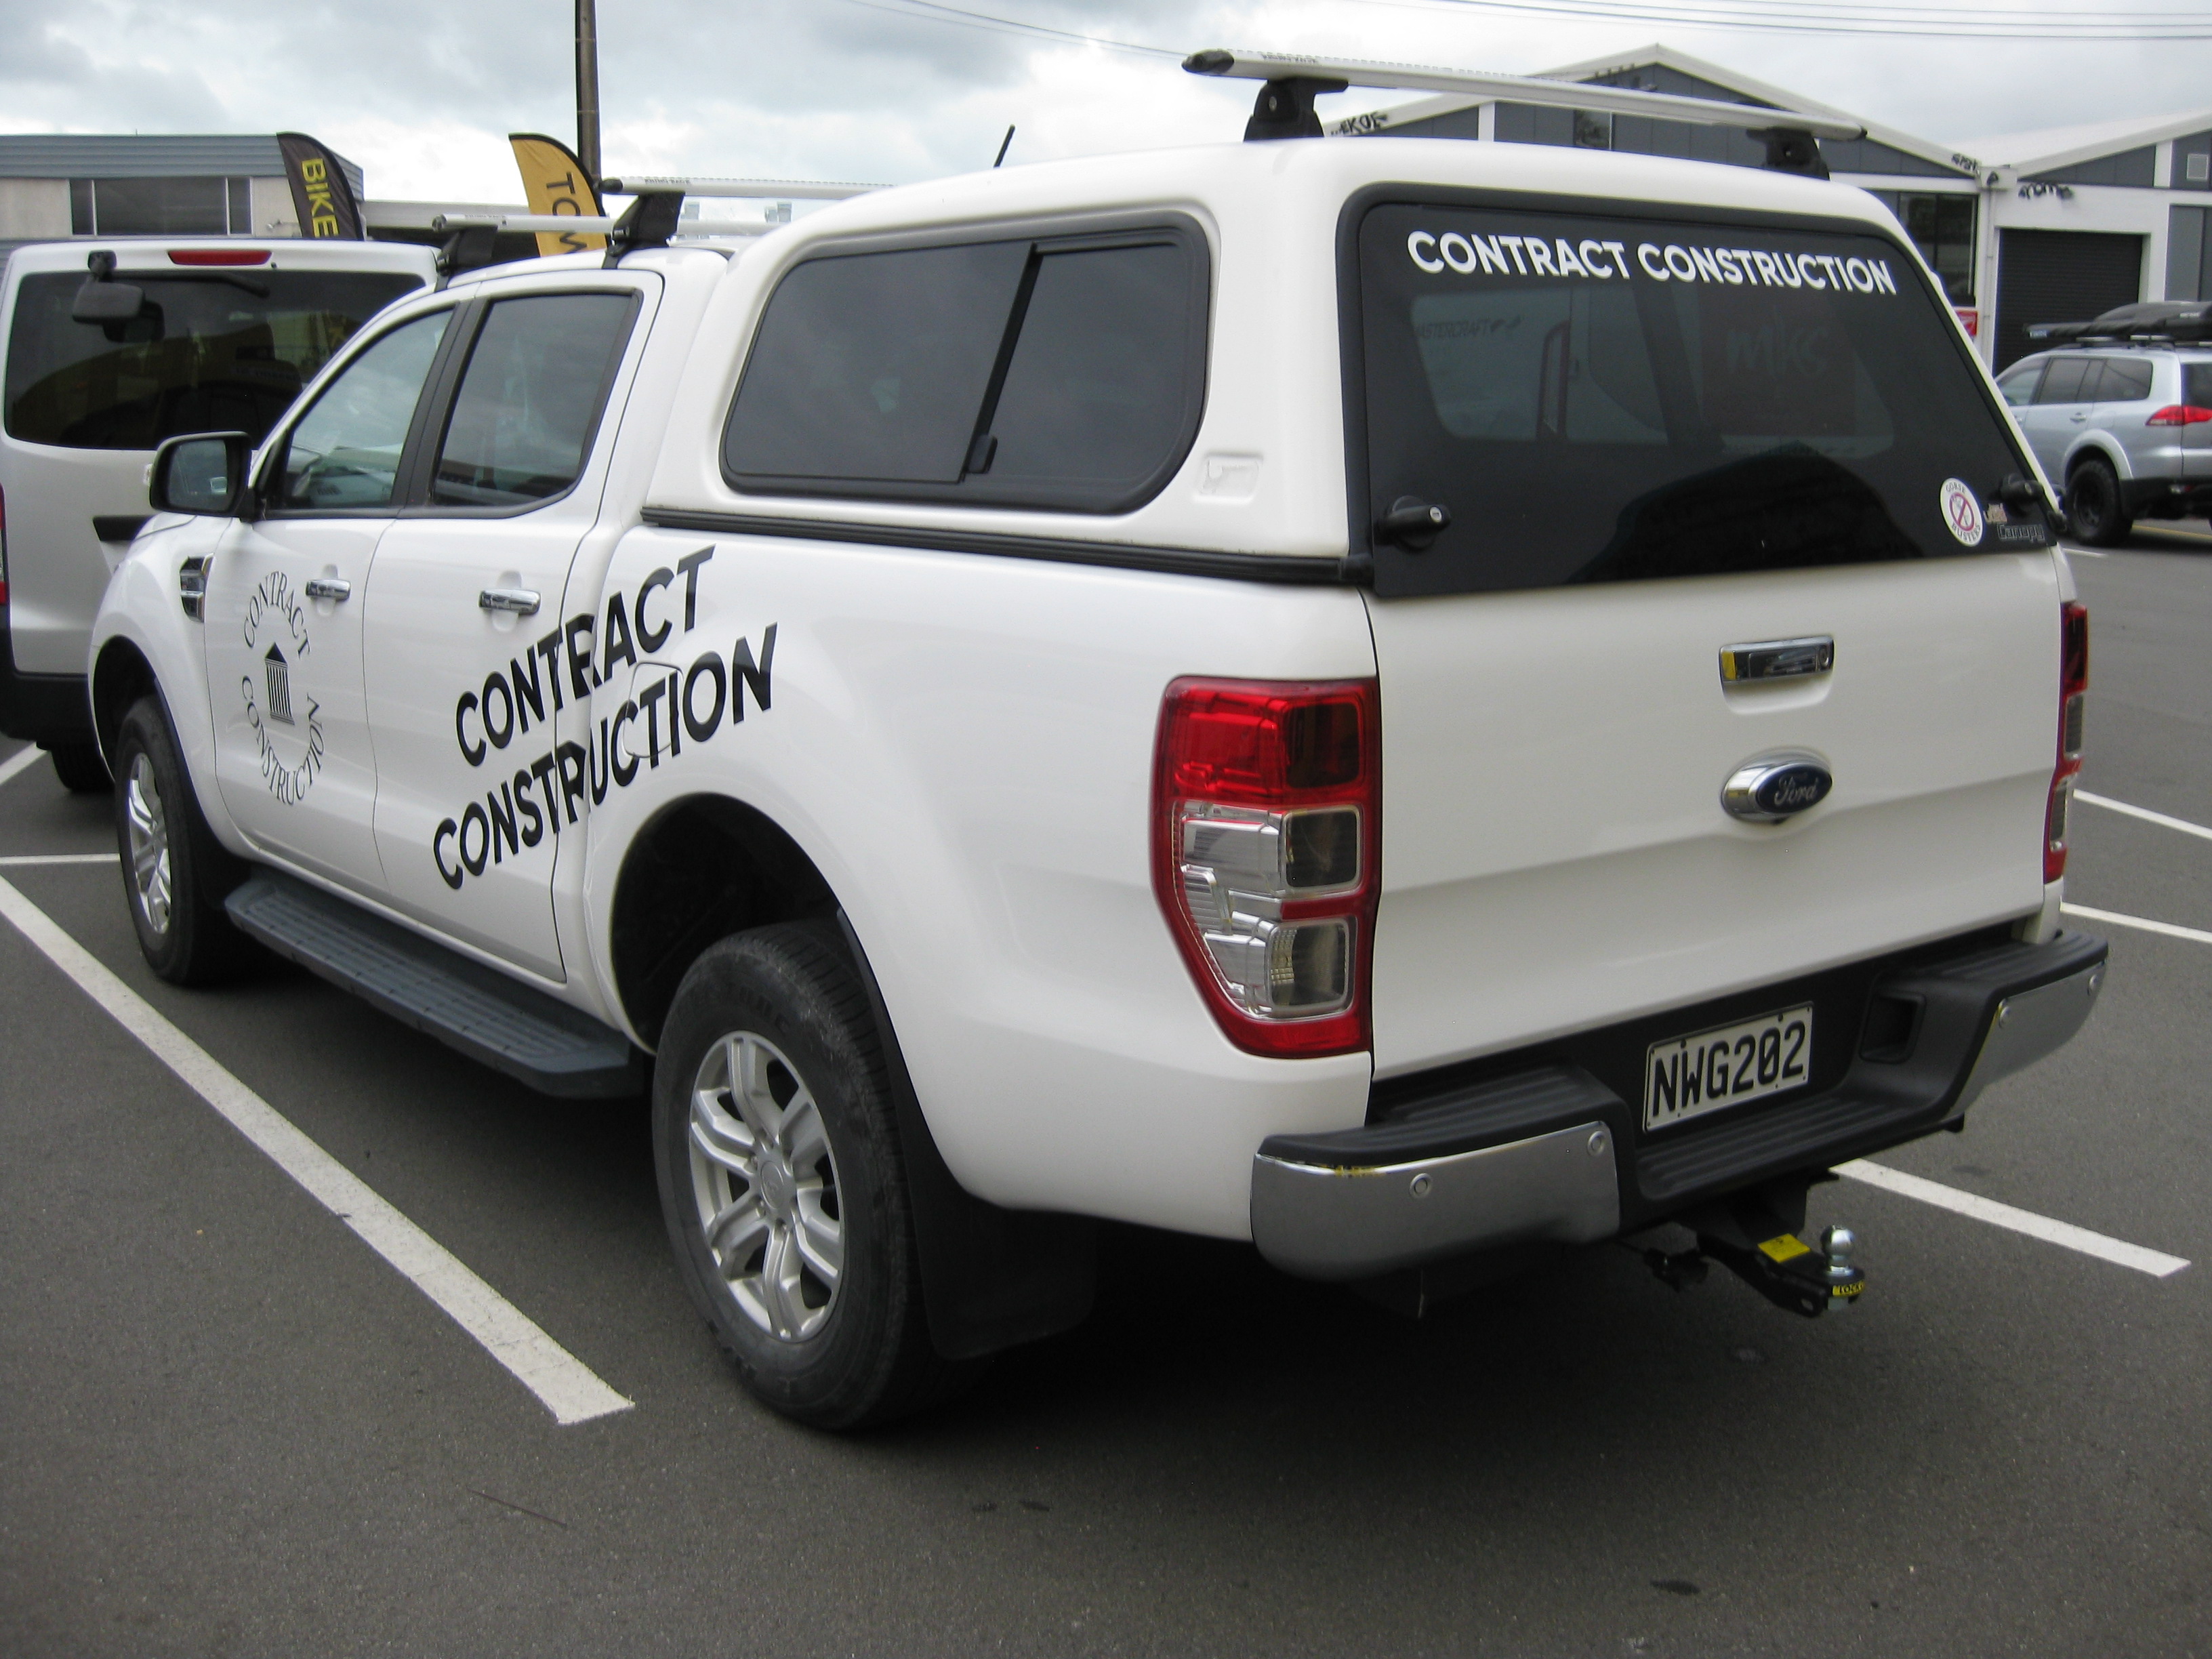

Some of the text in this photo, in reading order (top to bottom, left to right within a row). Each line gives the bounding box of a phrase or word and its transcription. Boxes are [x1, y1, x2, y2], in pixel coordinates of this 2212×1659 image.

[302, 158, 339, 238] BIKE
[1407, 231, 1897, 295] CONTRACT CONSTRUCTION
[1951, 523, 1981, 542] BUSTERS
[1998, 525, 2045, 541] Canopy
[244, 571, 310, 660] CONTRACT
[456, 544, 716, 766] CONTRACT
[242, 676, 325, 806] CONSTRUCTION
[434, 622, 777, 889] CONSTRUCTION
[1774, 777, 1819, 805] Ford
[1653, 1021, 1805, 1117] NWG202
